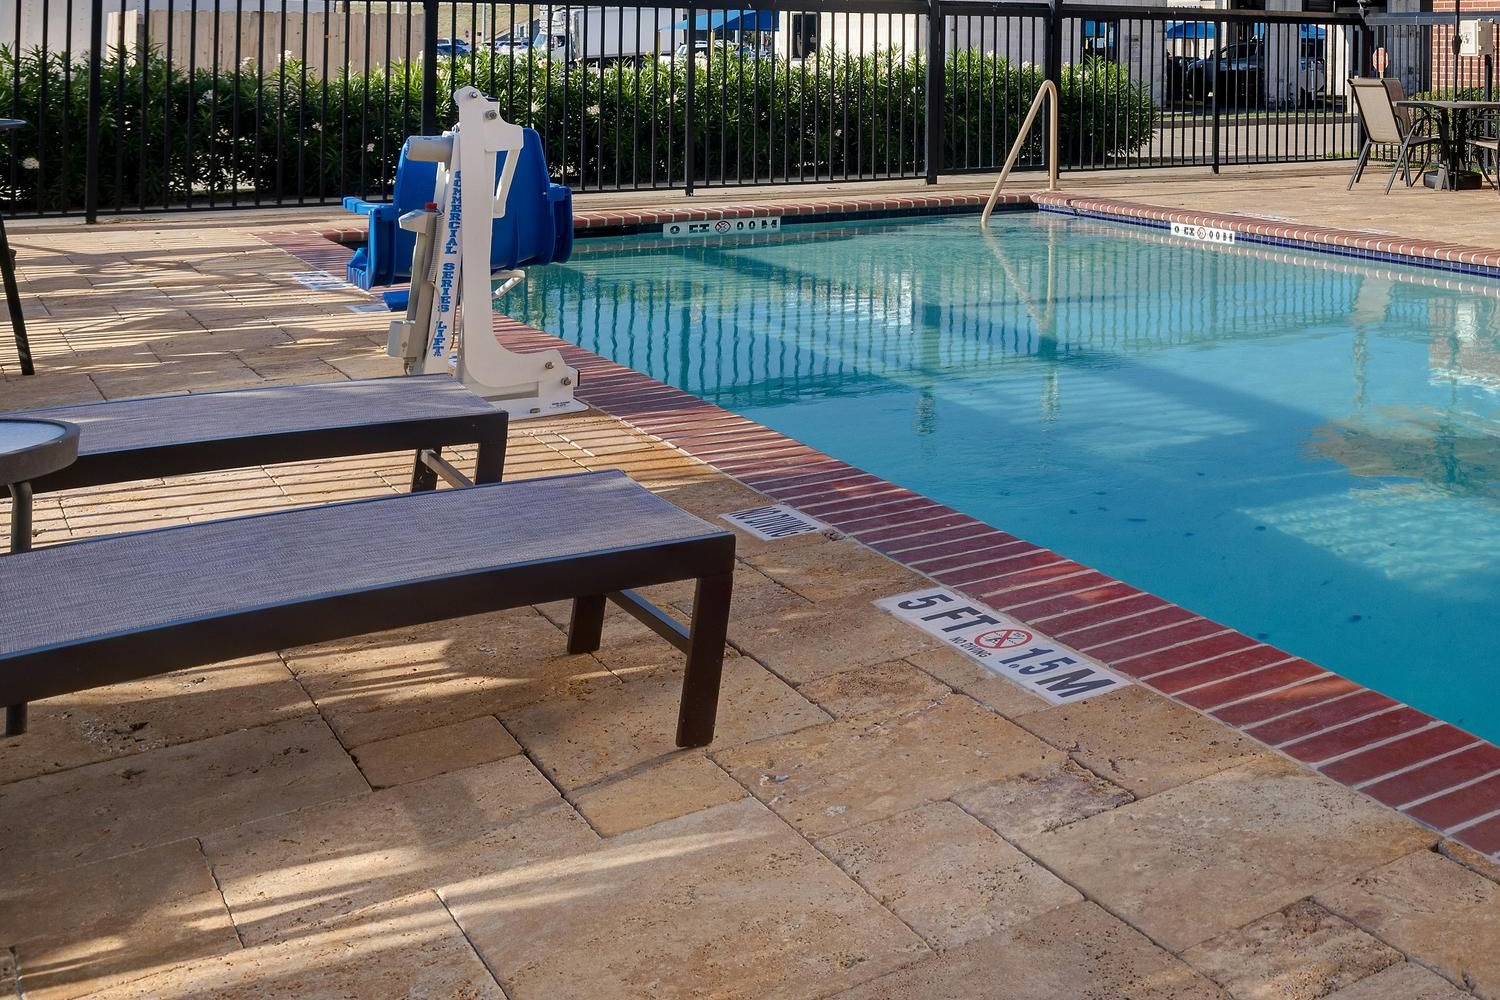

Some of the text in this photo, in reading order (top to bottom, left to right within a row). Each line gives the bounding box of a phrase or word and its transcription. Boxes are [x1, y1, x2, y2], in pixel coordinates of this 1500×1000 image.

[438, 263, 455, 313] SERIES
[949, 636, 992, 658] NO DIVING
